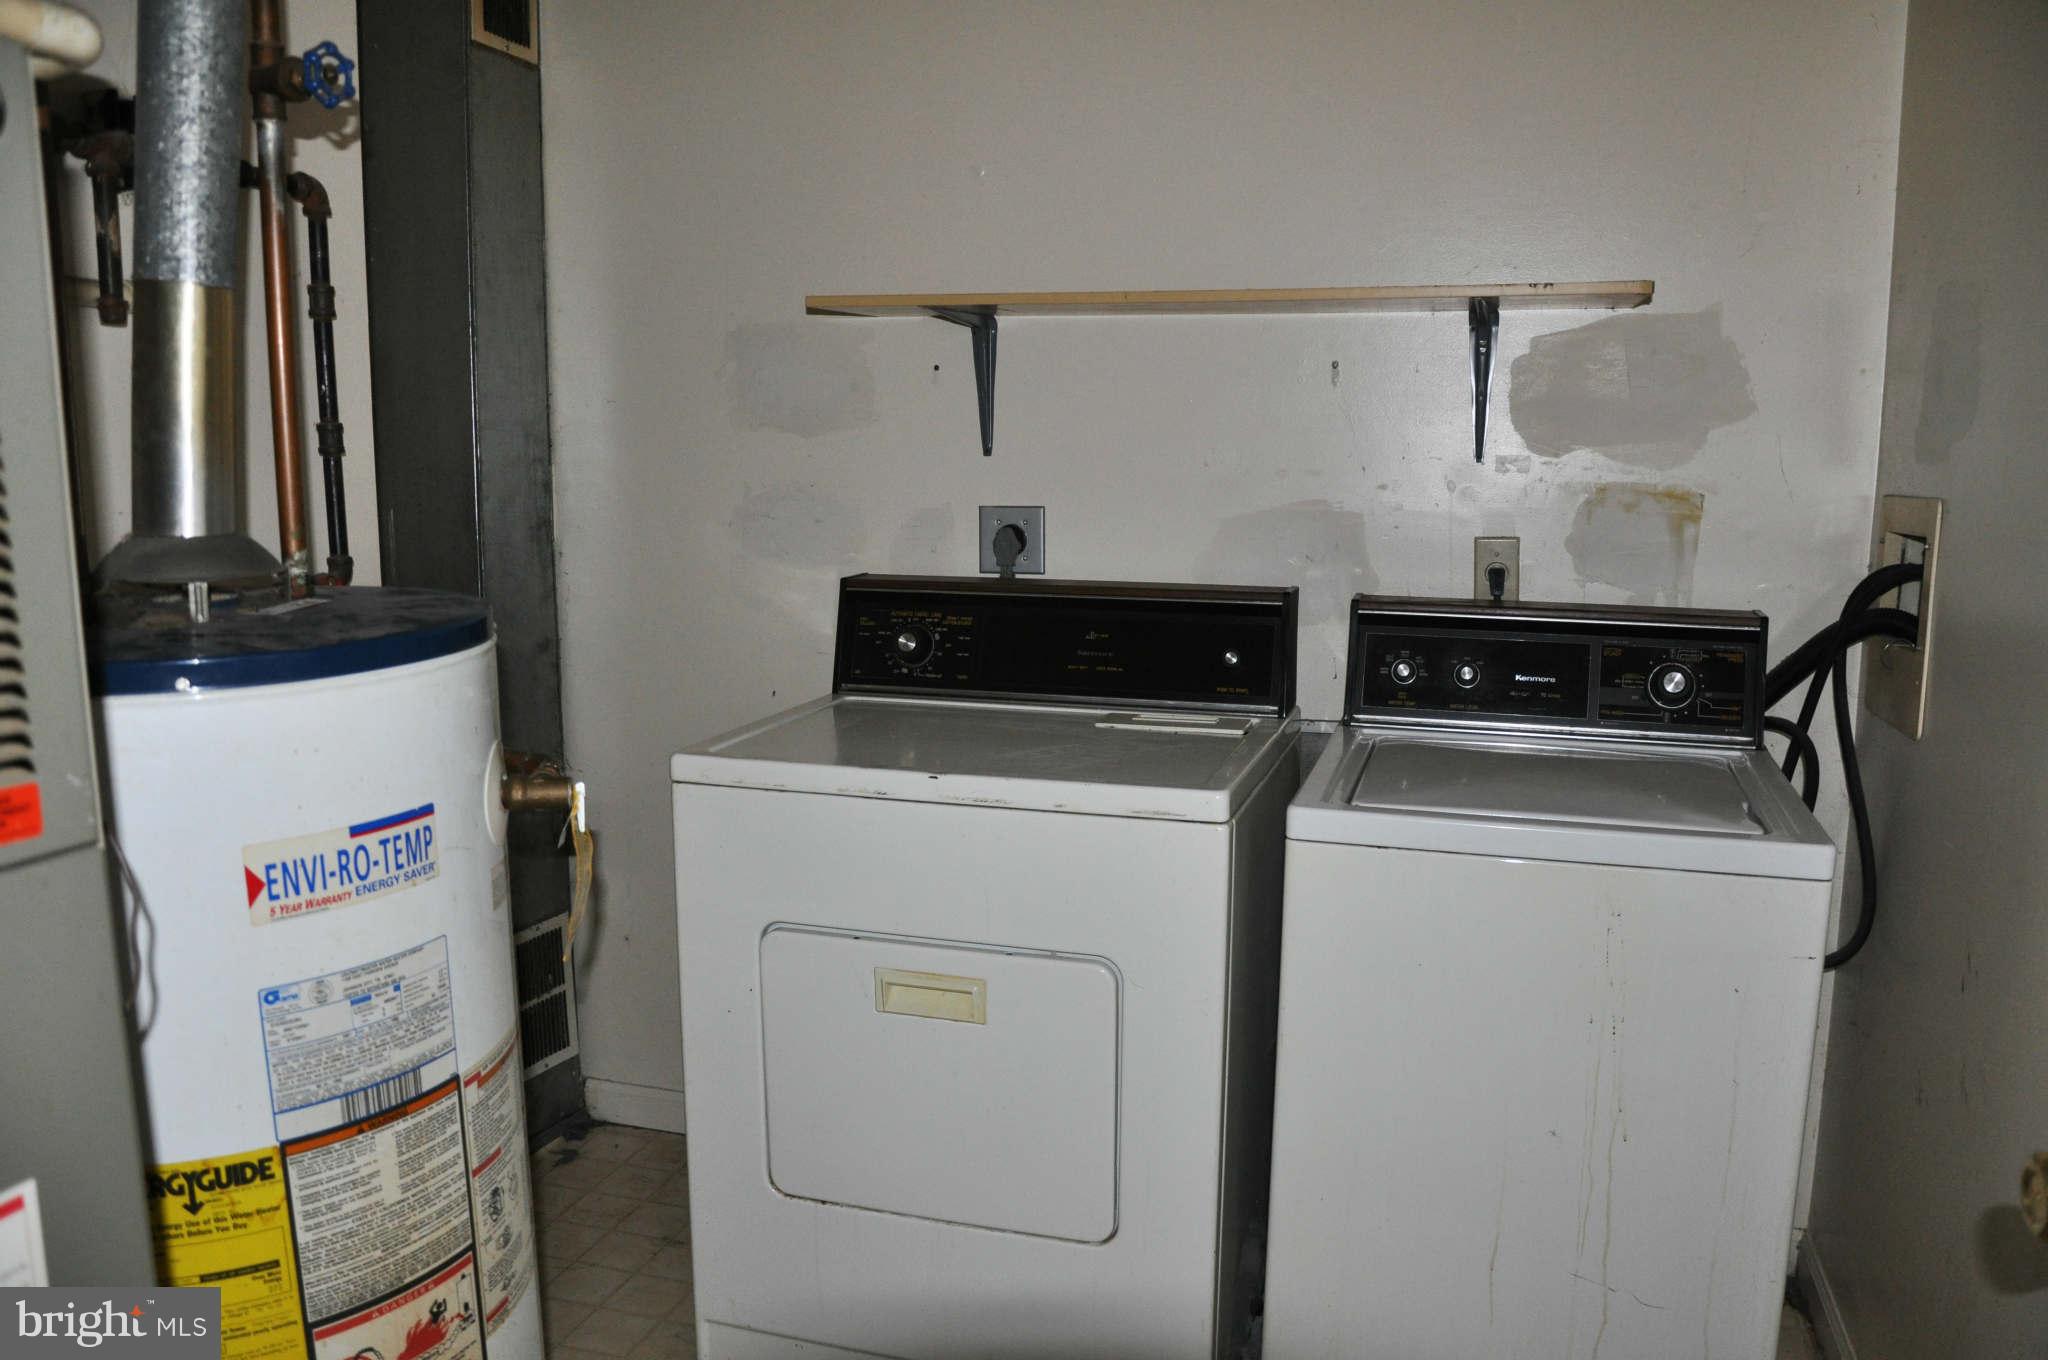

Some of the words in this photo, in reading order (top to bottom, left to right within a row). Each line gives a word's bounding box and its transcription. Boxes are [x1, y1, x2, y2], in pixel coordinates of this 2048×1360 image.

[1514, 673, 1557, 684] Kenmore
[264, 824, 434, 902] ENVI-RO-TEMP
[269, 906, 276, 918] 5
[279, 901, 303, 917] YEAR
[304, 891, 353, 911] WARRANTY
[355, 875, 401, 897] ENERGY
[403, 861, 435, 883] SAVER
